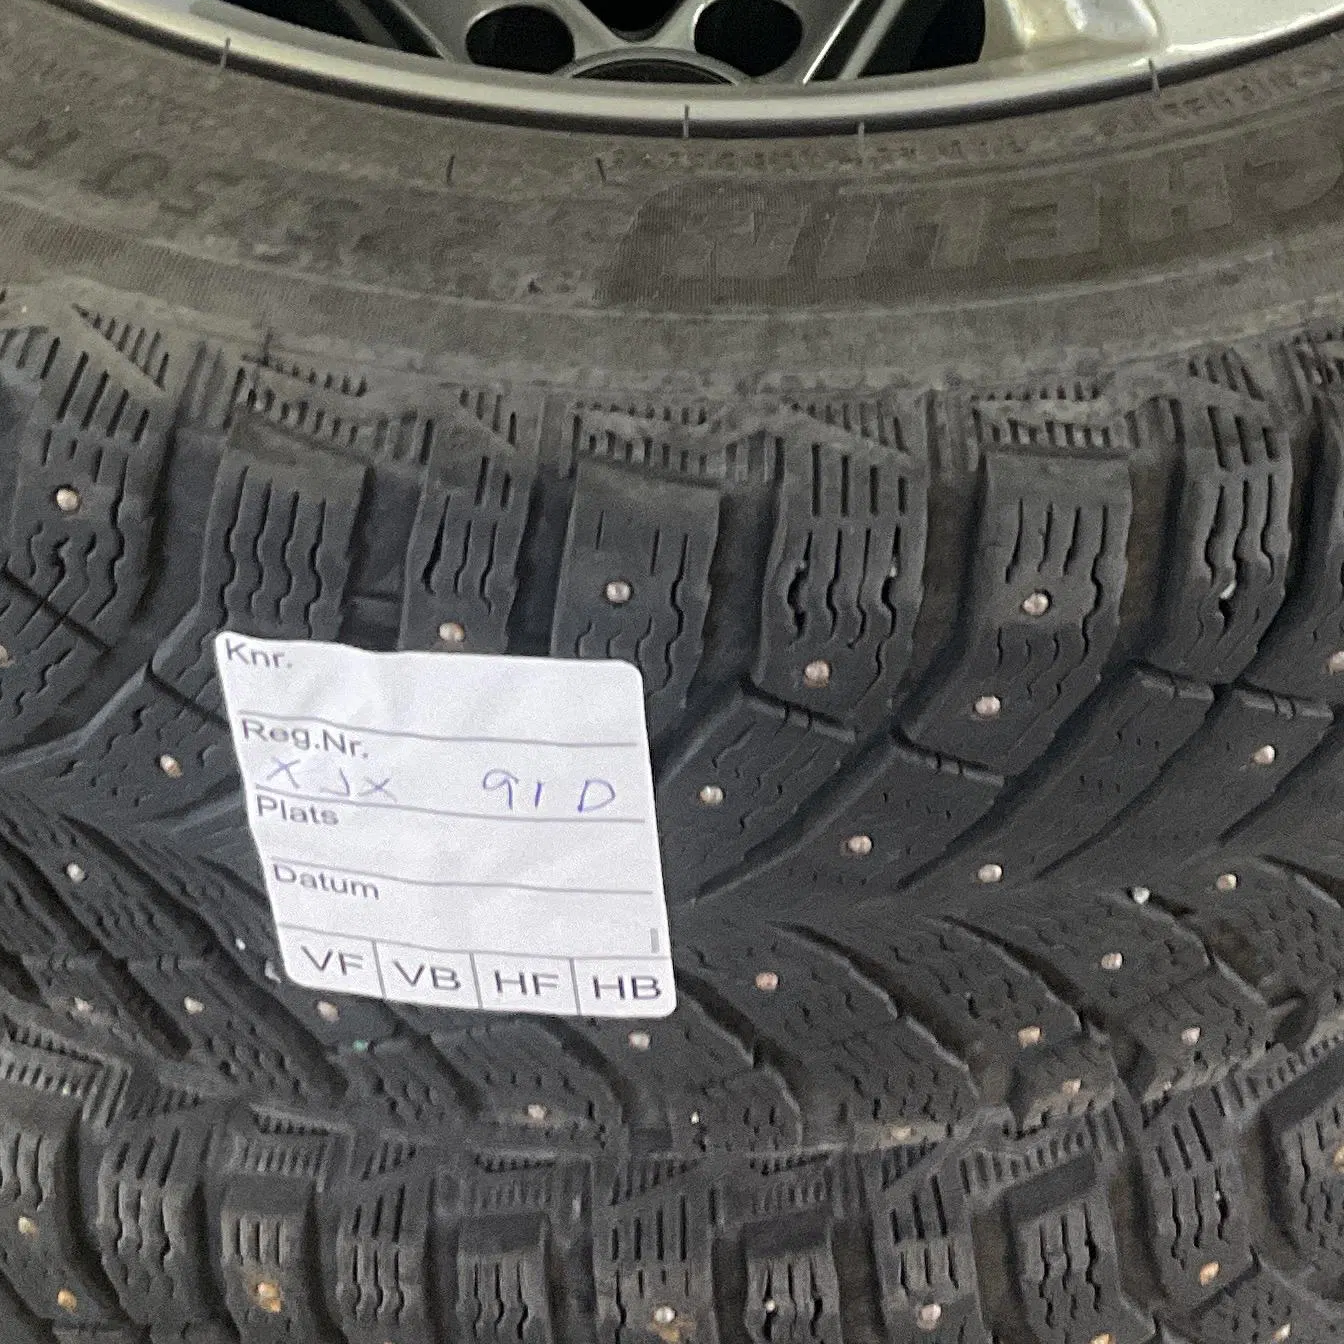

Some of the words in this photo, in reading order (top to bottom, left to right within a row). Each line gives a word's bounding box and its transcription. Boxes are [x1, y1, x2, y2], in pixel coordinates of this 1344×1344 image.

[225, 638, 292, 670] Knr.
[242, 718, 369, 759] Reg.Nr.
[255, 796, 339, 827] Plats
[273, 862, 380, 901] Datum
[301, 944, 363, 976] VF
[393, 959, 462, 992] VB
[494, 969, 559, 998] HF
[592, 974, 662, 1002] HB
